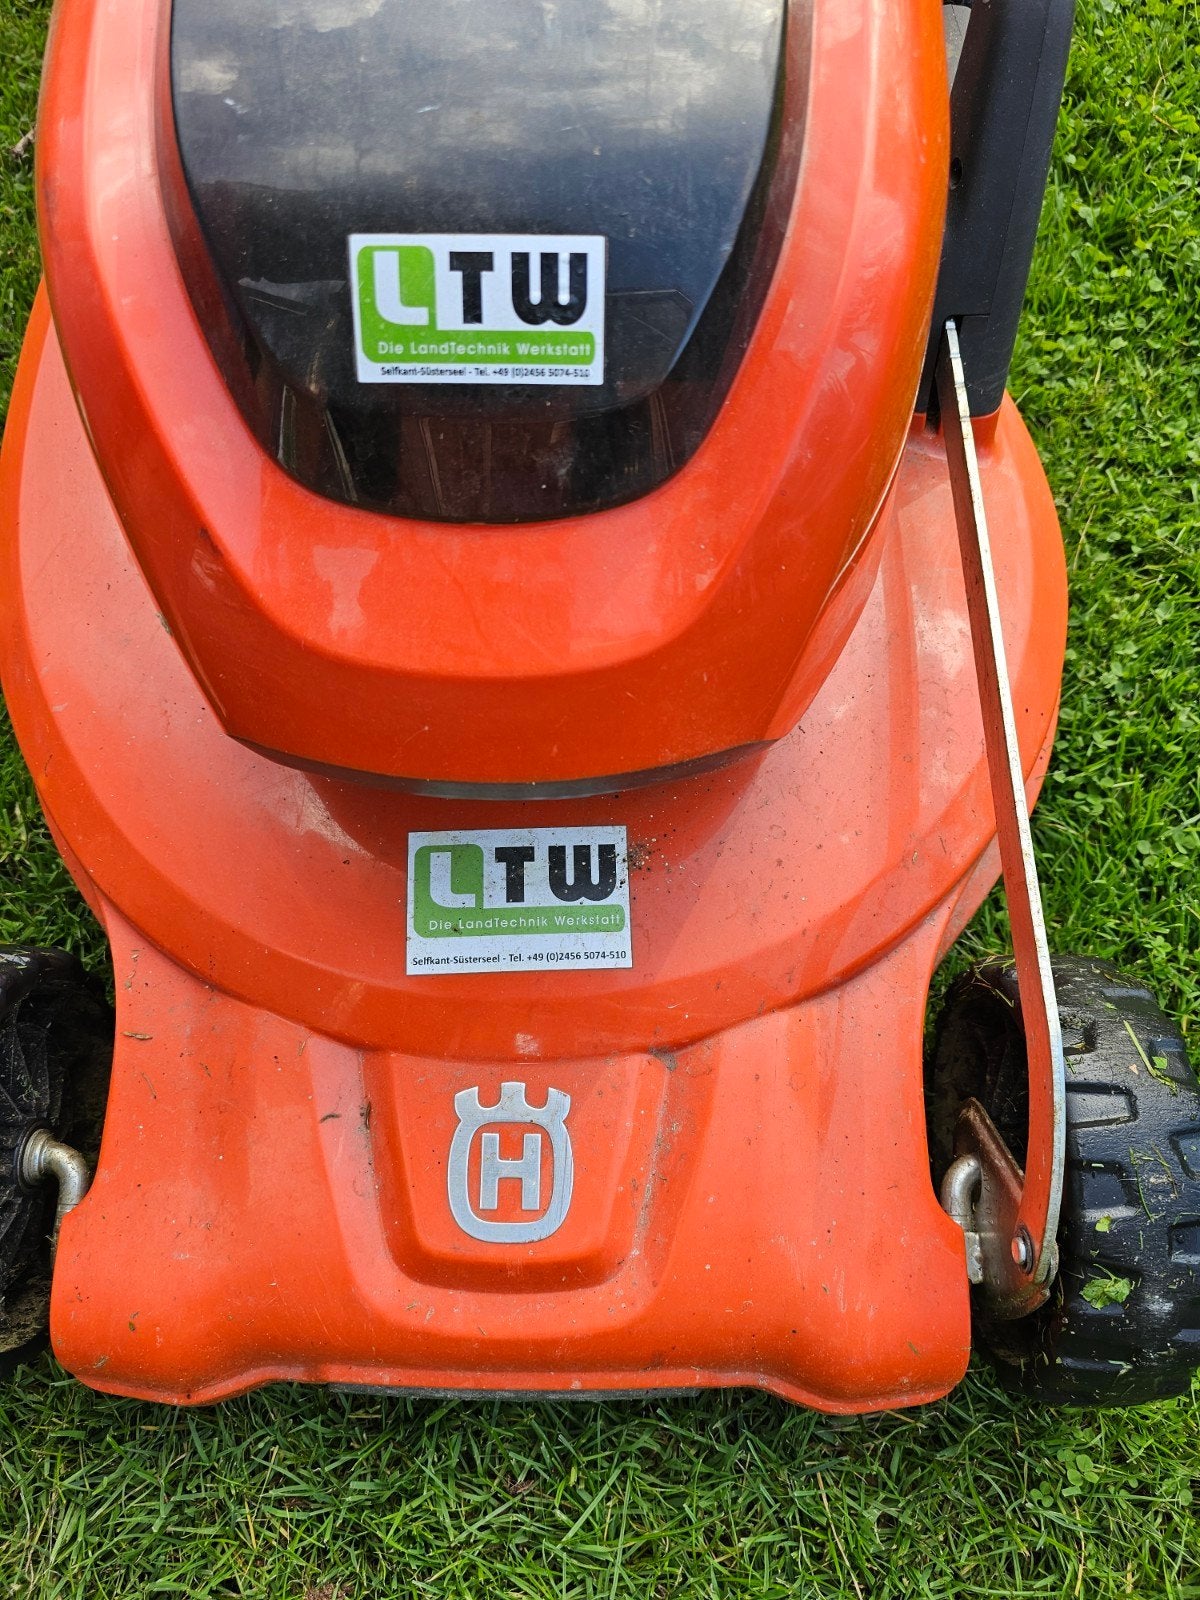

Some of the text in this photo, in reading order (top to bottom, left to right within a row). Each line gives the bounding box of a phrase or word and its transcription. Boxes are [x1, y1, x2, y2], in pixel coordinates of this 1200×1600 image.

[371, 250, 588, 326] LTW
[377, 341, 591, 357] Die LandTechnik Werkstatt
[474, 367, 489, 376] Tel.
[492, 367, 509, 377] +49
[429, 843, 617, 908] LTW
[429, 913, 622, 931] Die LandTechnik Werkstatt
[412, 954, 501, 966] Selfkant-Süsterseel
[508, 953, 525, 963] Tel.
[526, 952, 544, 962] +49
[546, 951, 582, 963] (0)2456
[583, 950, 627, 960] 5074-510
[479, 1132, 542, 1210] H
